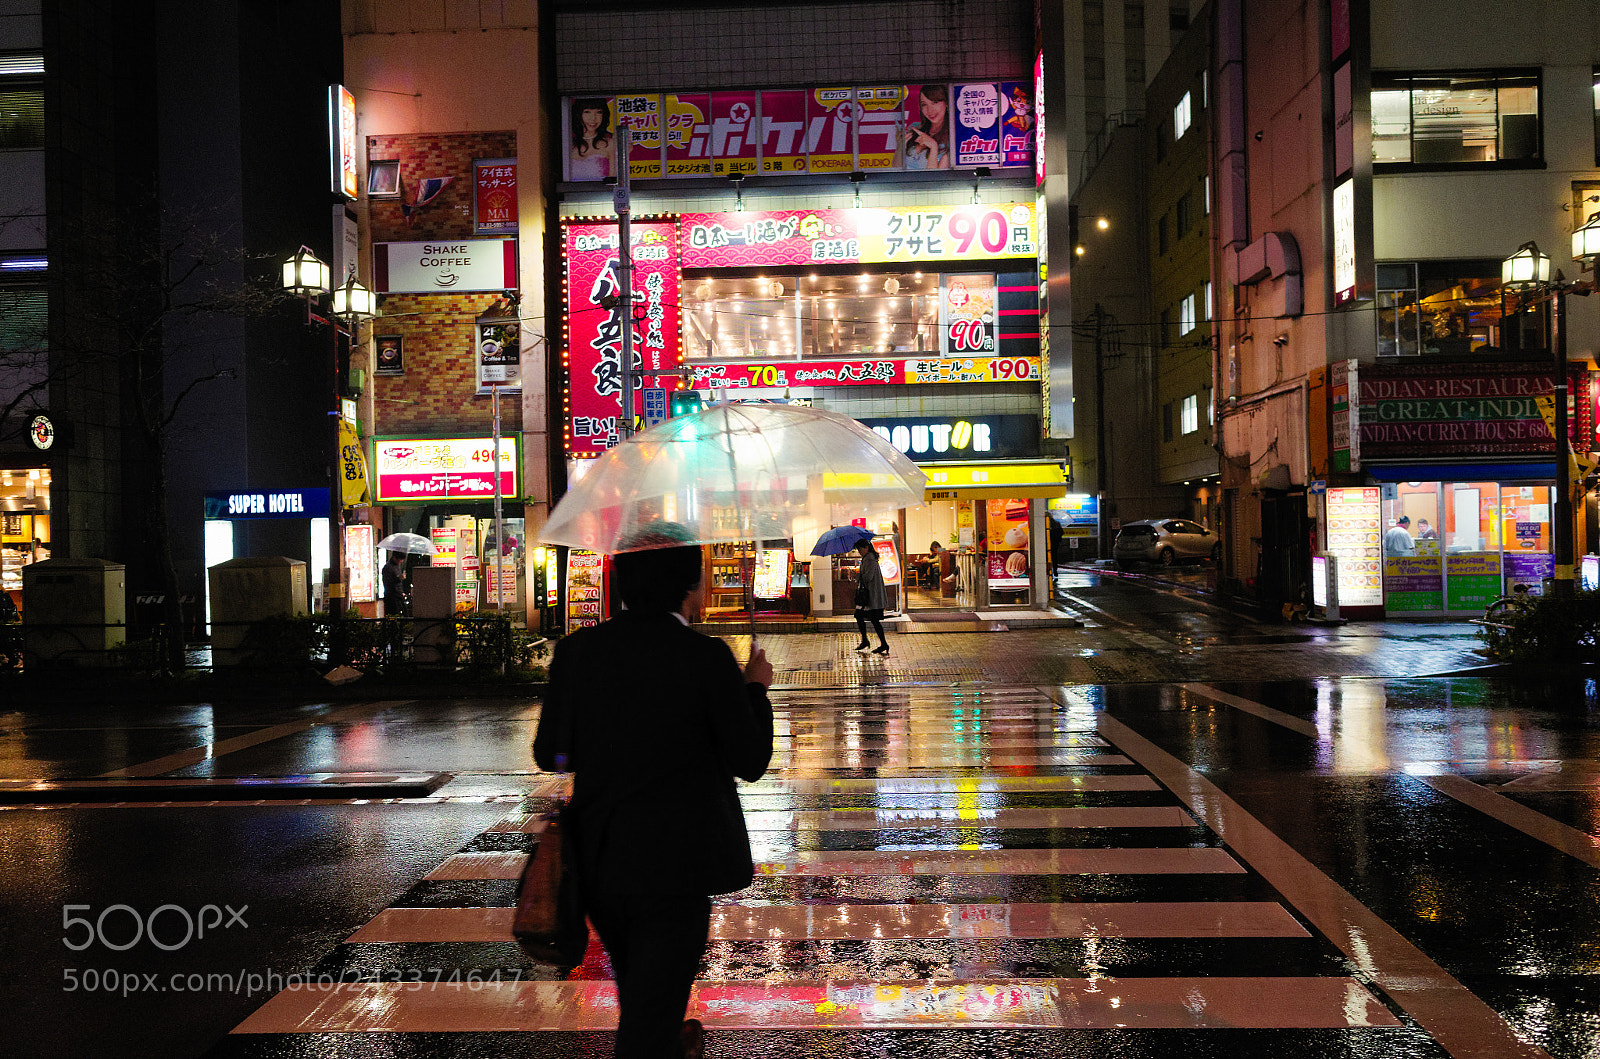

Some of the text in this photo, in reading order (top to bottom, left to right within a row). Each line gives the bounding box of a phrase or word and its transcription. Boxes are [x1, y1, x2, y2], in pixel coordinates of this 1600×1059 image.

[963, 91, 986, 99] 全国の
[963, 99, 998, 107] キャバクラ
[617, 97, 657, 113] 池袋で
[963, 107, 994, 115] 求人情報
[1423, 104, 1460, 116] design
[619, 114, 695, 129] キャバクラ
[688, 102, 909, 157] ポケパラ
[811, 158, 891, 169] POKEPARA STUDIO
[481, 167, 513, 178] タイ古式
[478, 179, 516, 189] マッサージ
[487, 208, 509, 219] MAI
[887, 214, 943, 234] クリア
[948, 211, 1008, 253] 90
[1013, 226, 1028, 242] 円
[423, 244, 468, 255] SHAKE
[812, 238, 860, 259] 居酒屋
[886, 236, 942, 256] アサヒ
[420, 257, 472, 268] COFFEE
[483, 326, 497, 337] 2F
[950, 319, 985, 350] 90
[747, 365, 779, 386] 70
[916, 361, 963, 374] 生ビール
[989, 359, 1030, 380] 190
[1359, 376, 1562, 399] INDIAN RESTAURAN
[646, 392, 655, 418] 自転車
[655, 392, 664, 418] 歩行者
[1378, 401, 1469, 421] GREAT
[574, 416, 616, 437] 旨い!
[1417, 423, 1473, 441] CURRY
[1475, 422, 1527, 441] HOUSE
[228, 493, 304, 514] SUPER HOTEL
[584, 588, 598, 599] 70
[582, 603, 597, 614] 90
